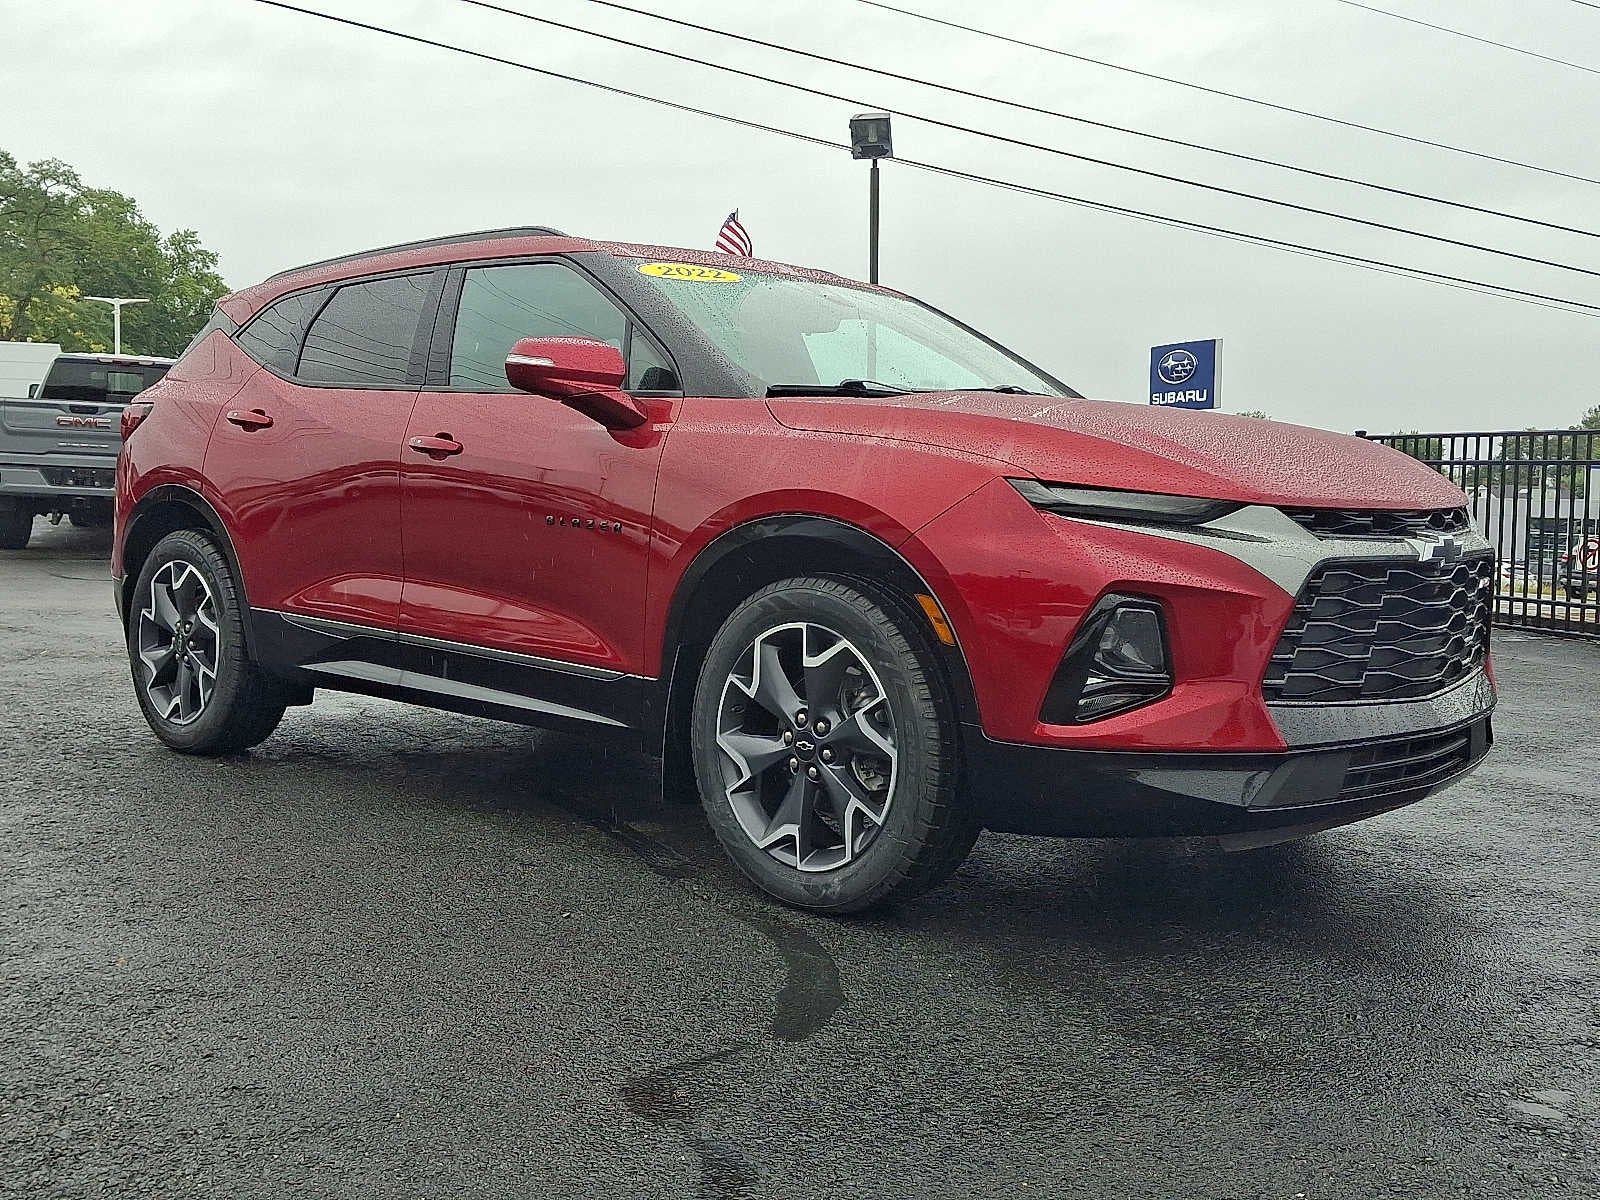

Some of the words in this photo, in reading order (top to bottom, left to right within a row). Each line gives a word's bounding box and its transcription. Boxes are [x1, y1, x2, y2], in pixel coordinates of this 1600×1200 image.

[657, 265, 726, 279] 2022
[1152, 389, 1206, 404] SUBARU
[56, 416, 111, 429] GMC
[545, 515, 622, 533] BLAZER
